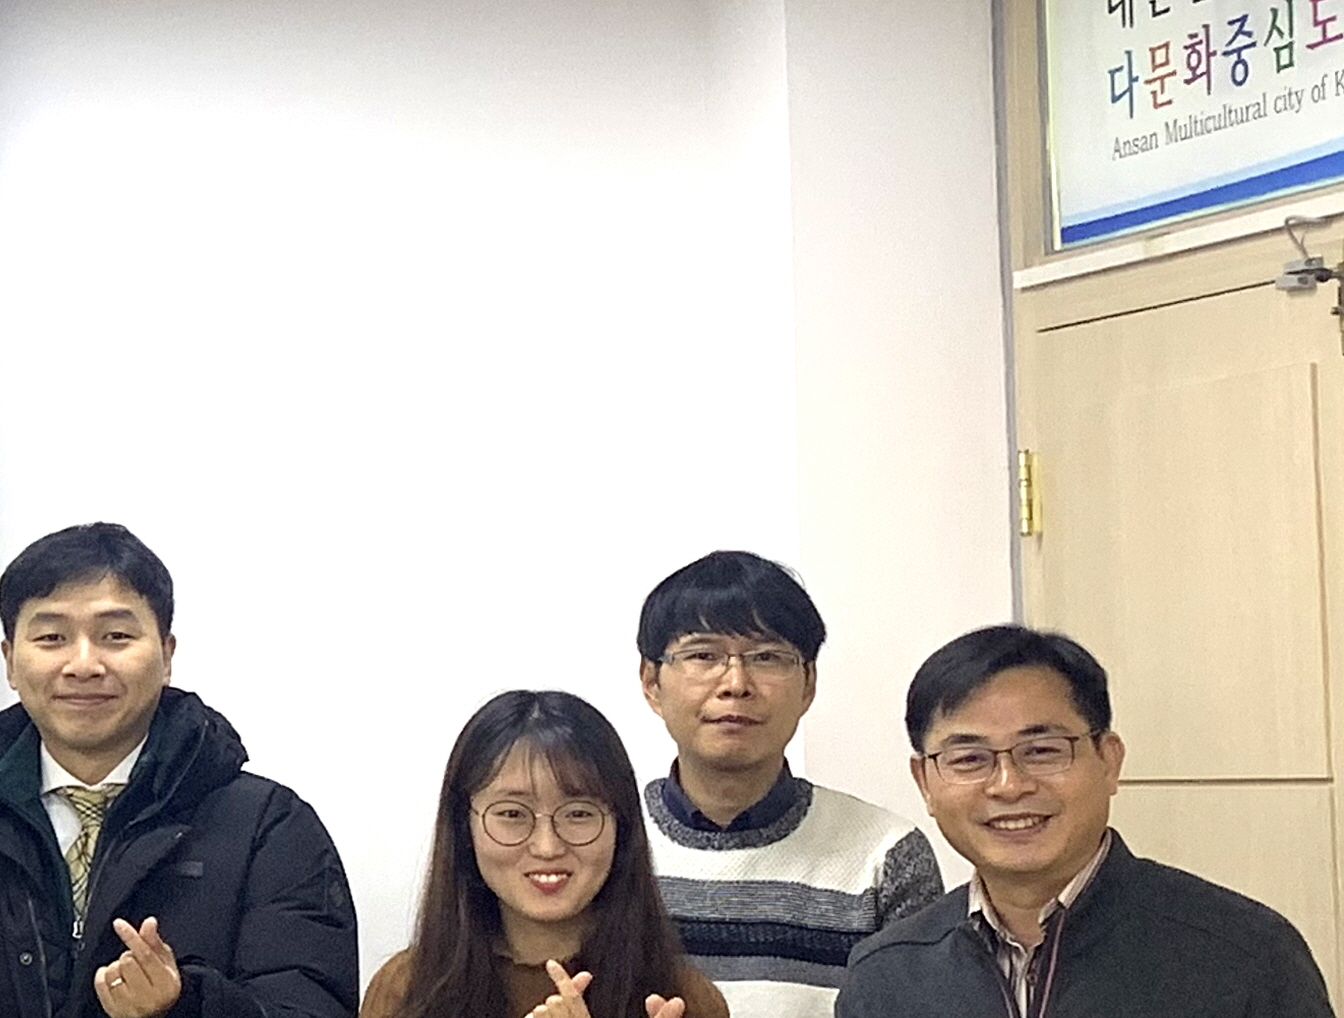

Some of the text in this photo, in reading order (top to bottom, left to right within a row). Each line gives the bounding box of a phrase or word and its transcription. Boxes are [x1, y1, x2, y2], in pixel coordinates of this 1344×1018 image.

[1112, 131, 1159, 161] Ansan
[1164, 92, 1268, 146] Multicultural
[1273, 85, 1305, 115] city
[1311, 73, 1328, 104] of
